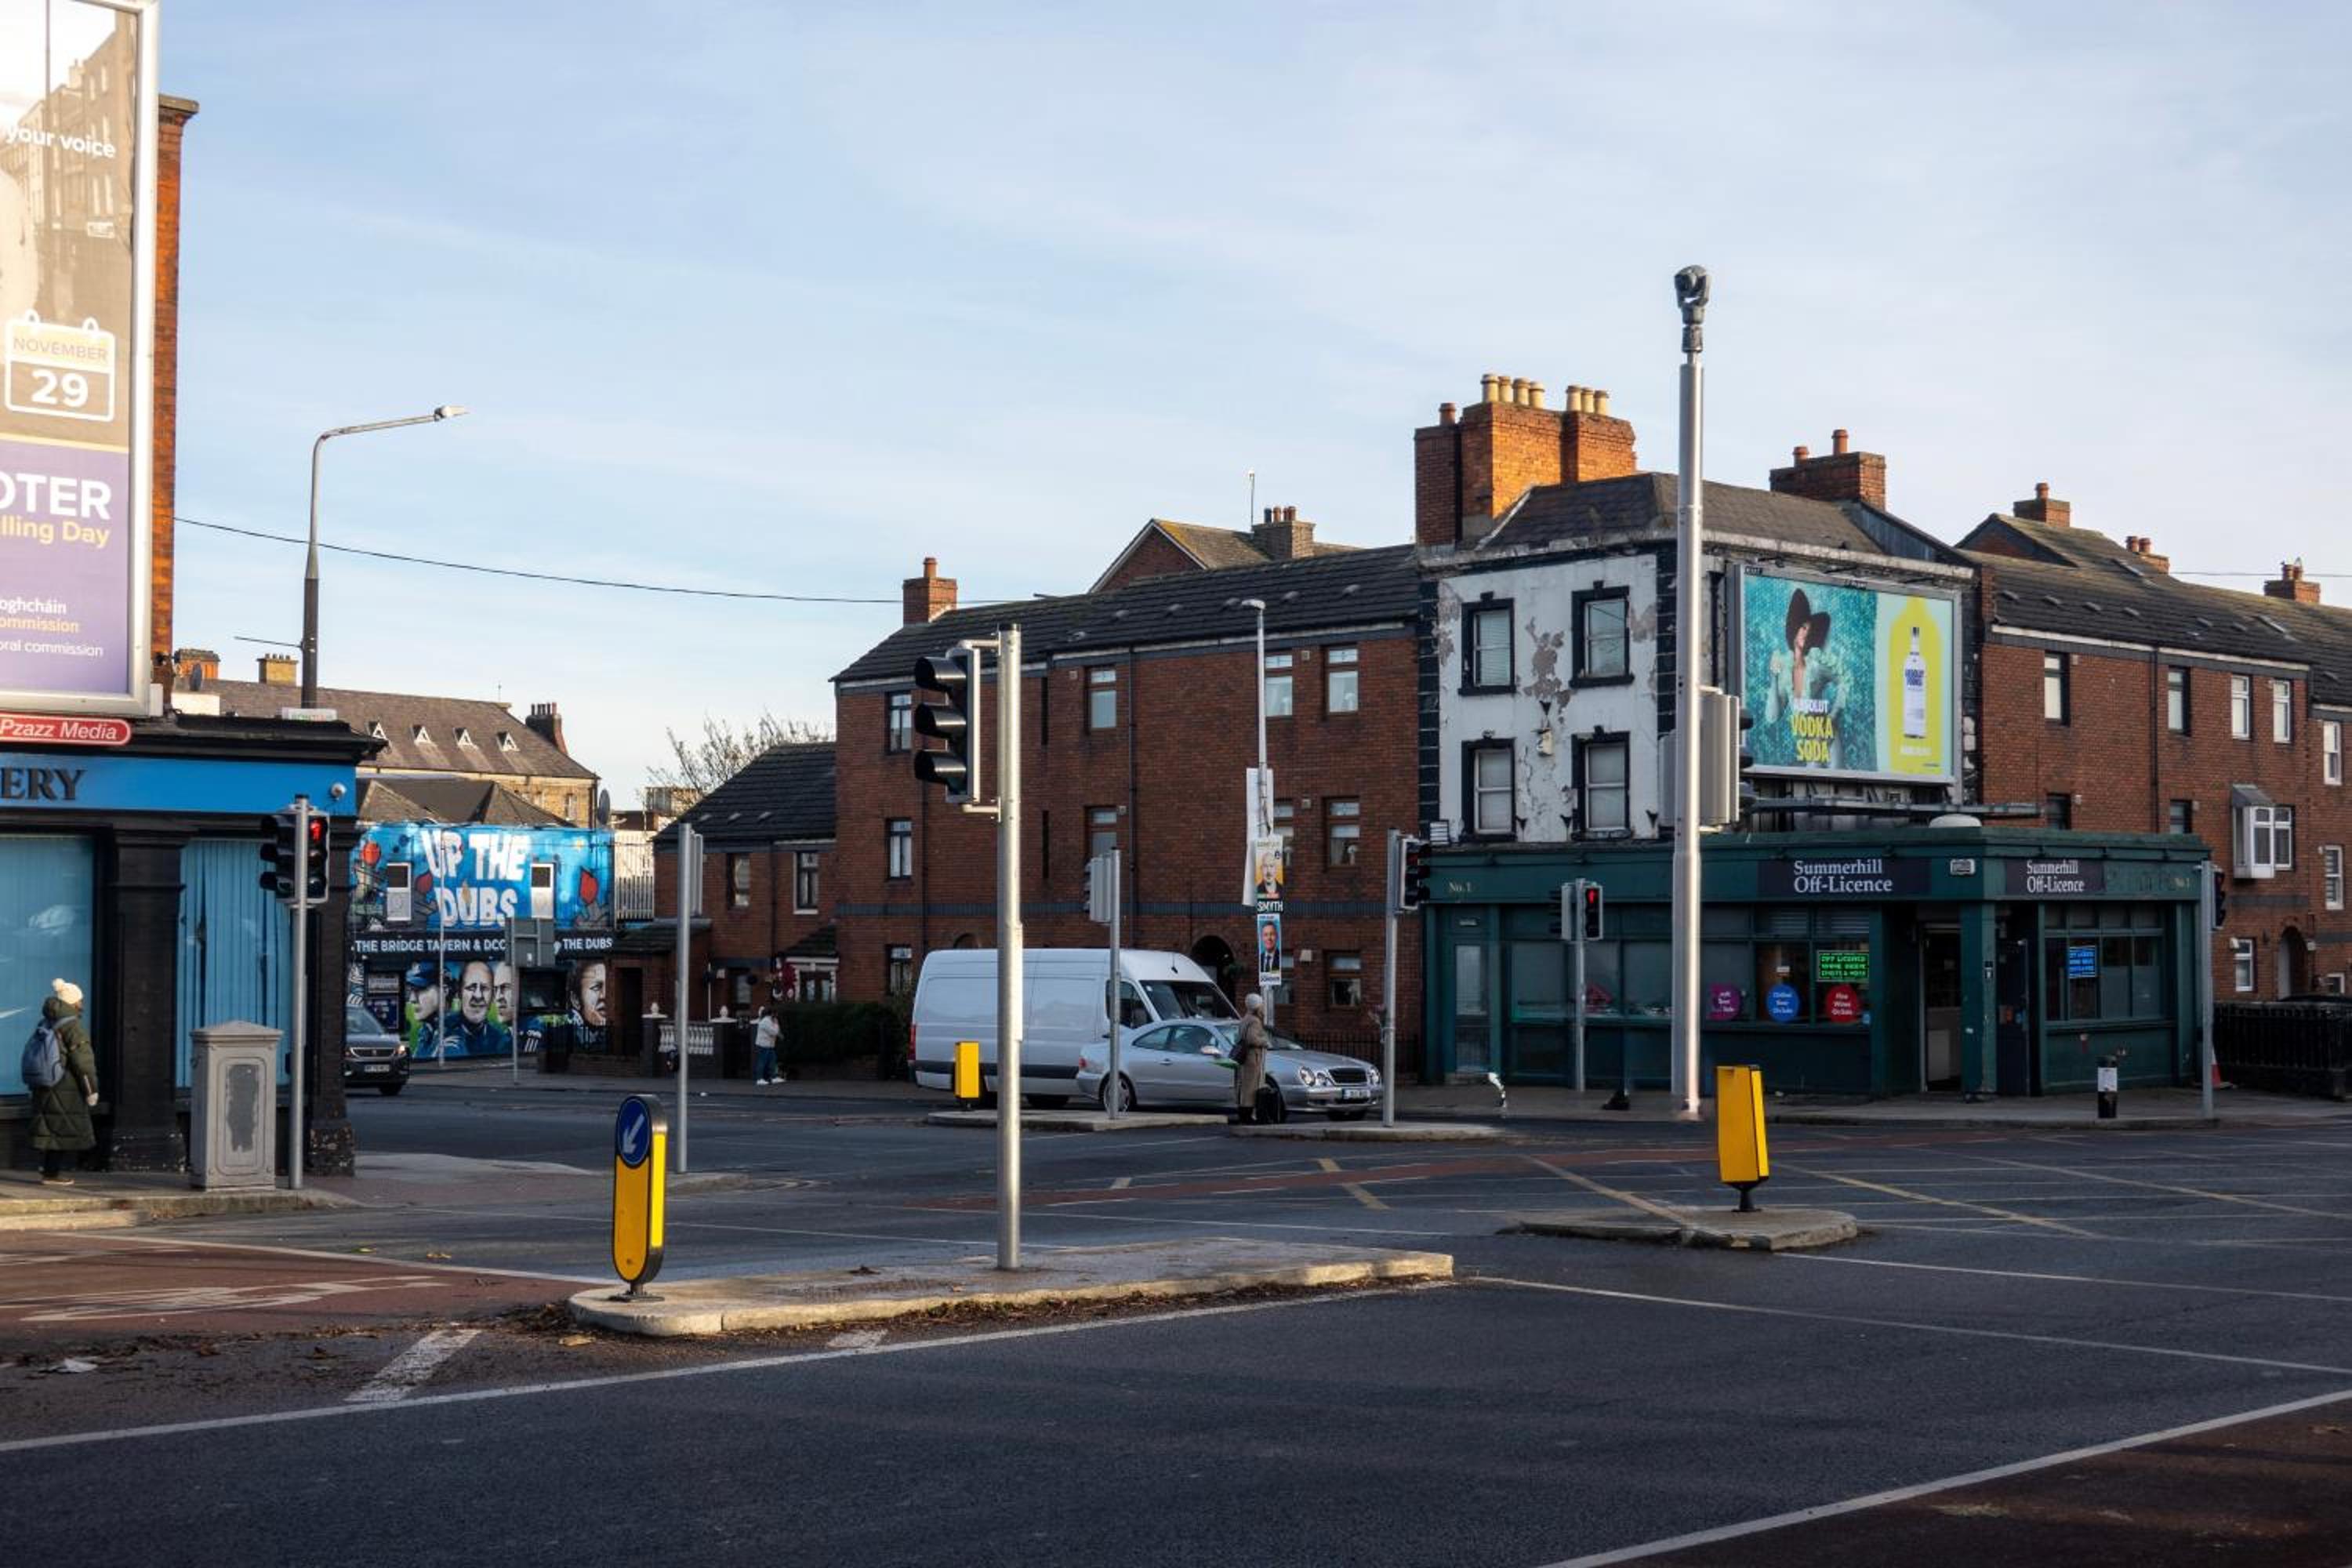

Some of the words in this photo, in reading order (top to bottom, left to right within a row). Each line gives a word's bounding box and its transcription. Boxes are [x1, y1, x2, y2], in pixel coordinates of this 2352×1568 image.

[5, 125, 56, 147] your
[60, 132, 116, 158] voice
[13, 337, 108, 361] NOVEMBER
[31, 368, 89, 407] 29
[1, 514, 55, 545] lling
[63, 520, 110, 549] Day
[0, 616, 79, 633] ommission
[0, 639, 21, 653] ral
[24, 641, 103, 657] commission
[0, 718, 55, 738] Pzazz
[60, 721, 118, 740] Media
[1790, 714, 1834, 739] VODKA
[1796, 739, 1832, 762] SODA
[0, 767, 88, 800] ERY
[420, 826, 463, 877] UP
[468, 832, 532, 880] THE
[1793, 858, 1882, 875] Summerhill
[2027, 858, 2078, 874] Summerhill
[1794, 876, 1893, 893] Off-Licence
[2027, 876, 2085, 893] Off-Licence
[434, 887, 518, 927] DUBS
[355, 940, 378, 952] THE
[380, 940, 423, 952] BRIDGE
[426, 939, 470, 951] TAVERN
[473, 939, 481, 951] &
[562, 938, 583, 950] THE
[586, 938, 612, 949] DUBS
